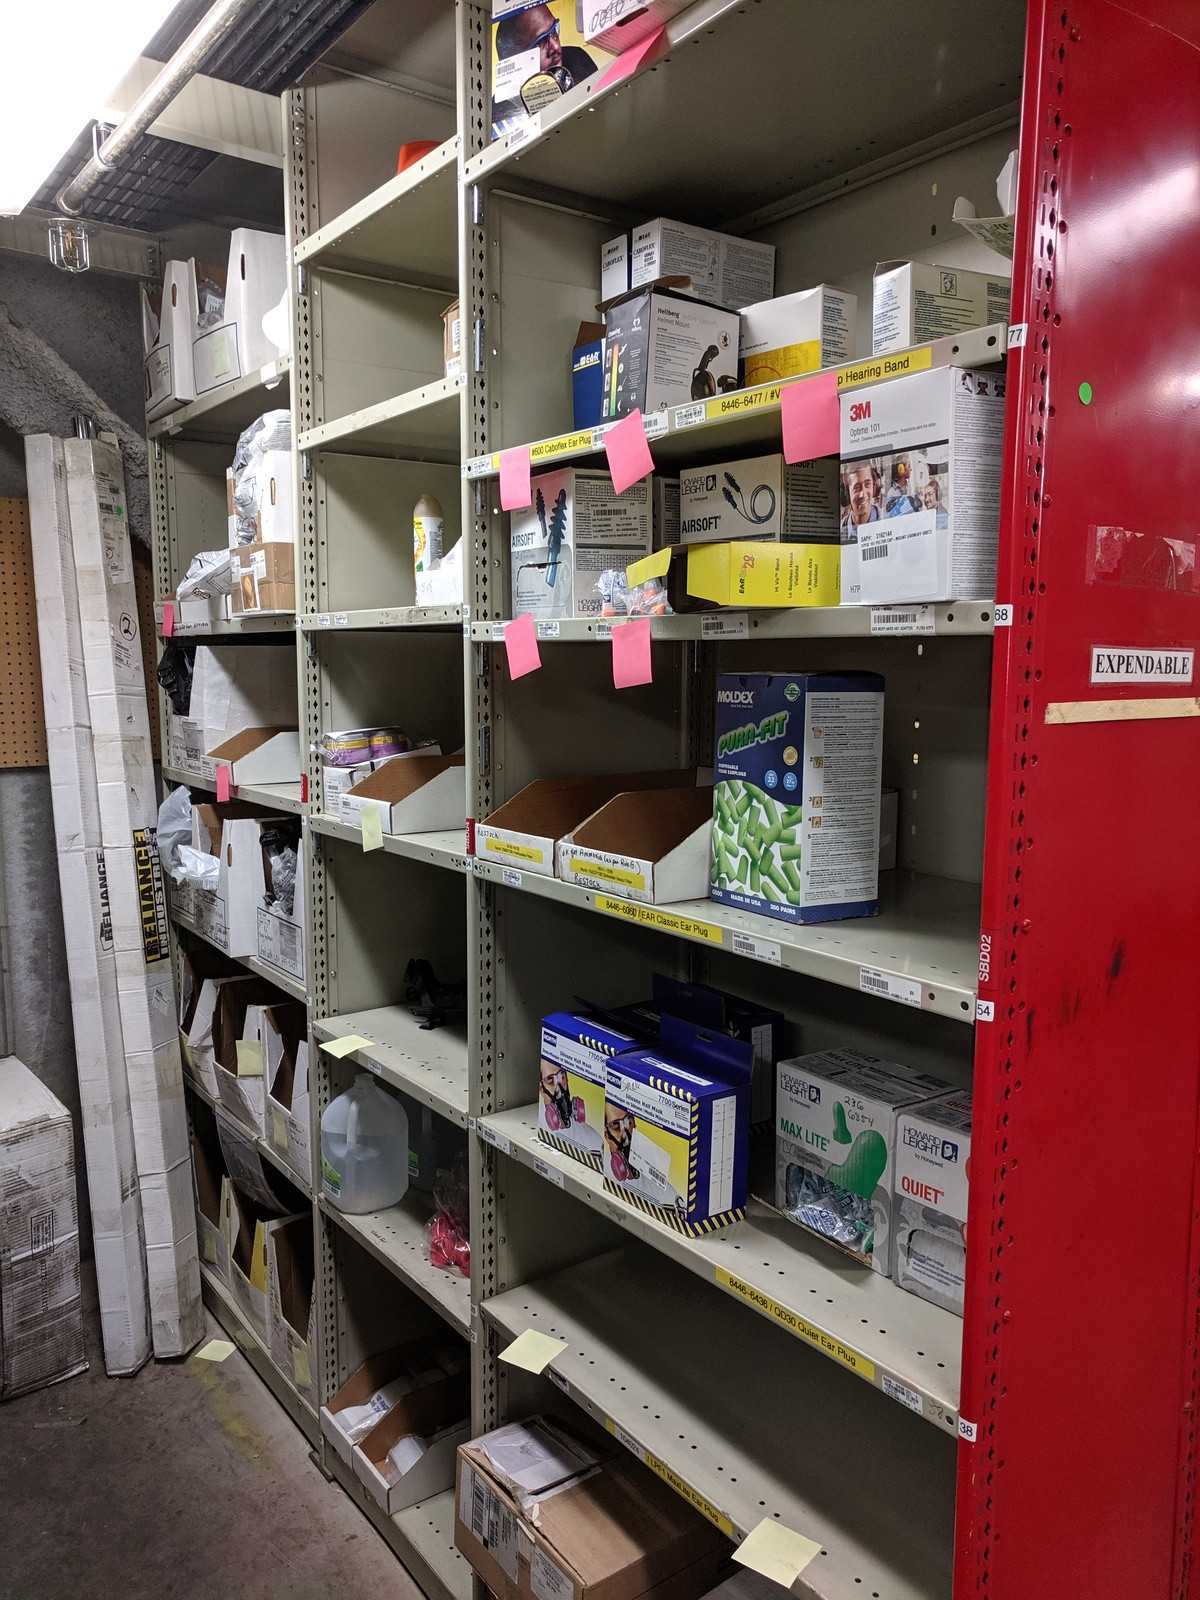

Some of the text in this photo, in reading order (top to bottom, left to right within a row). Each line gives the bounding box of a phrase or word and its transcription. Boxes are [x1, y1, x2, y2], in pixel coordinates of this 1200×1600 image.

[1009, 328, 1023, 343] 77
[846, 364, 882, 384] Hearing
[884, 357, 910, 374] Band
[850, 400, 871, 421] 3M
[870, 423, 881, 433] 101
[544, 440, 568, 455] Caboflex
[568, 437, 579, 448] Ear
[579, 434, 591, 447] Plug
[681, 516, 719, 535] AIRSOFT
[511, 531, 535, 548] AIRSOFT
[994, 608, 1008, 620] 68
[122, 616, 132, 636] 2
[1095, 653, 1190, 675] EXPENDABLE
[717, 690, 754, 704] MOLDEX
[96, 851, 114, 942] RELIANCE
[136, 834, 160, 961] RELIANCE
[730, 894, 744, 902] MADE
[750, 899, 761, 907] USA
[780, 906, 796, 915] PAIRS
[641, 909, 655, 923] EAR
[656, 914, 679, 929] Classic
[680, 920, 692, 932] Ear
[692, 923, 709, 937] Plug
[979, 934, 992, 982] SBD02
[977, 1004, 991, 1017] 54
[780, 1072, 808, 1090] HOWARD
[780, 1080, 808, 1099] LEIGHT
[658, 1095, 690, 1114] 7700 Series
[780, 1117, 829, 1152] MAX LITE
[903, 1125, 941, 1146] HOWARD
[903, 1134, 941, 1157] LEIGHT
[901, 1176, 943, 1204] QUIET
[774, 1308, 796, 1328] QD30
[797, 1321, 819, 1342] Quiet
[820, 1334, 835, 1352] Ear
[836, 1344, 857, 1367] Plug
[959, 1422, 973, 1437] 38
[703, 1498, 721, 1523] Plug
